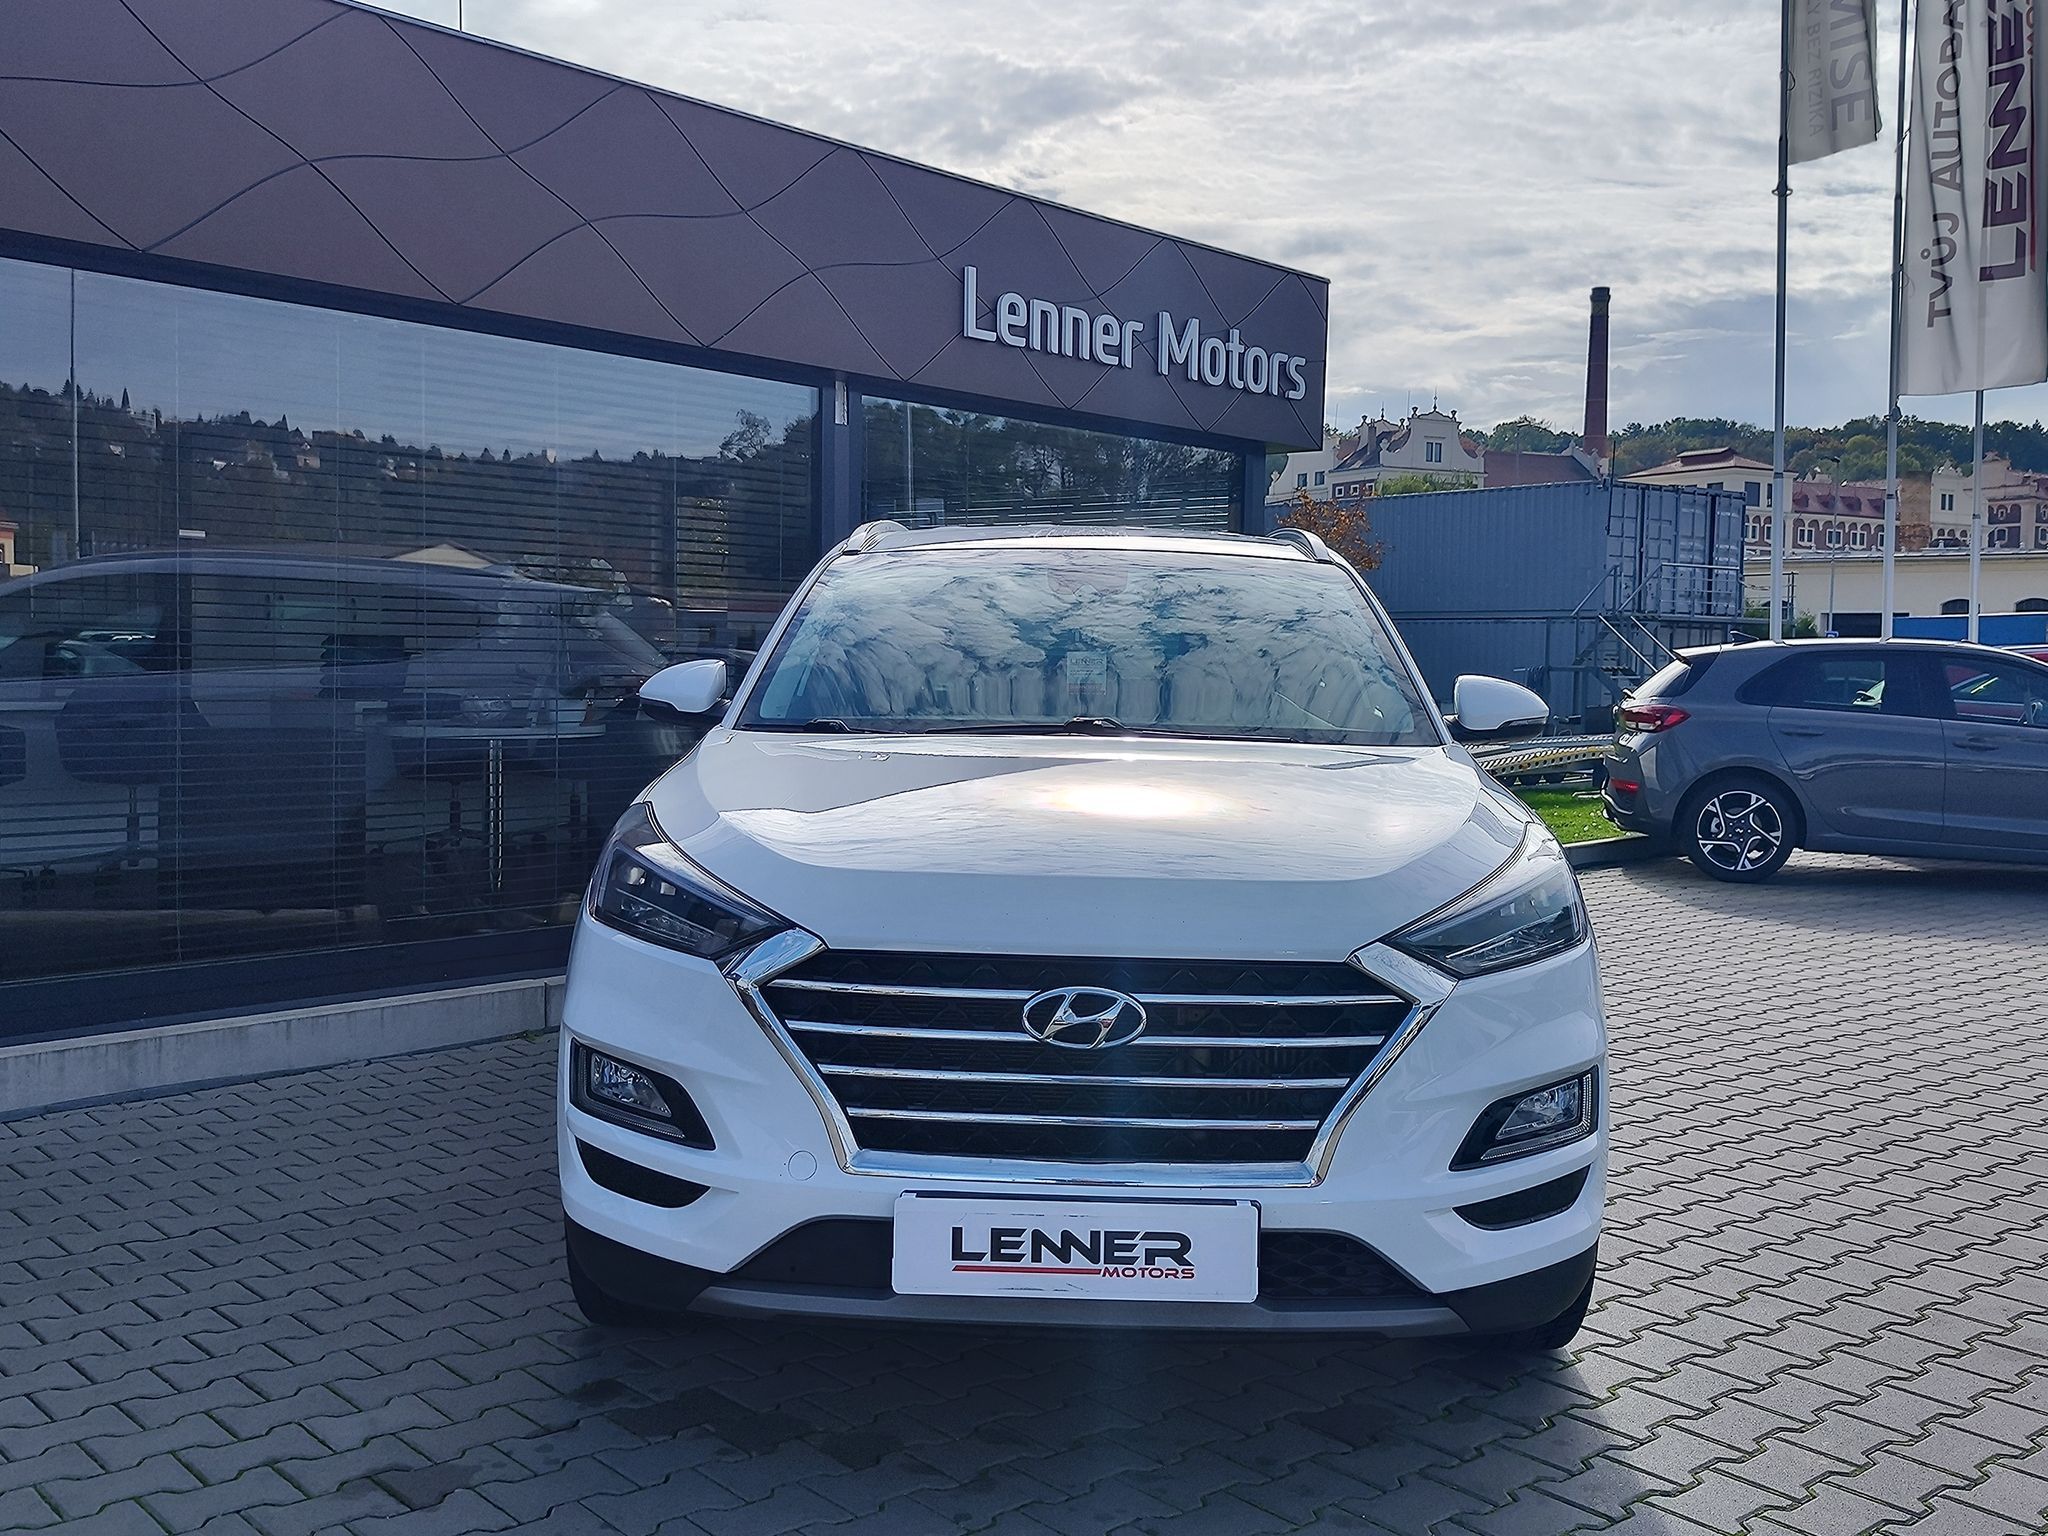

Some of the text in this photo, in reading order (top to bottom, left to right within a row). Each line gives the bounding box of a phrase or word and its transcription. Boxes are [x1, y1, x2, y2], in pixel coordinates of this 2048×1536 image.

[1807, 24, 1821, 63] BEZ
[1808, 67, 1824, 137] RIZIKA
[1979, 0, 2028, 282] LENNE
[1920, 212, 1960, 328] TVŮJ
[962, 264, 1307, 401] Lenner Motors
[951, 1226, 1195, 1267] LENNER
[1101, 1266, 1195, 1280] MOTORS
